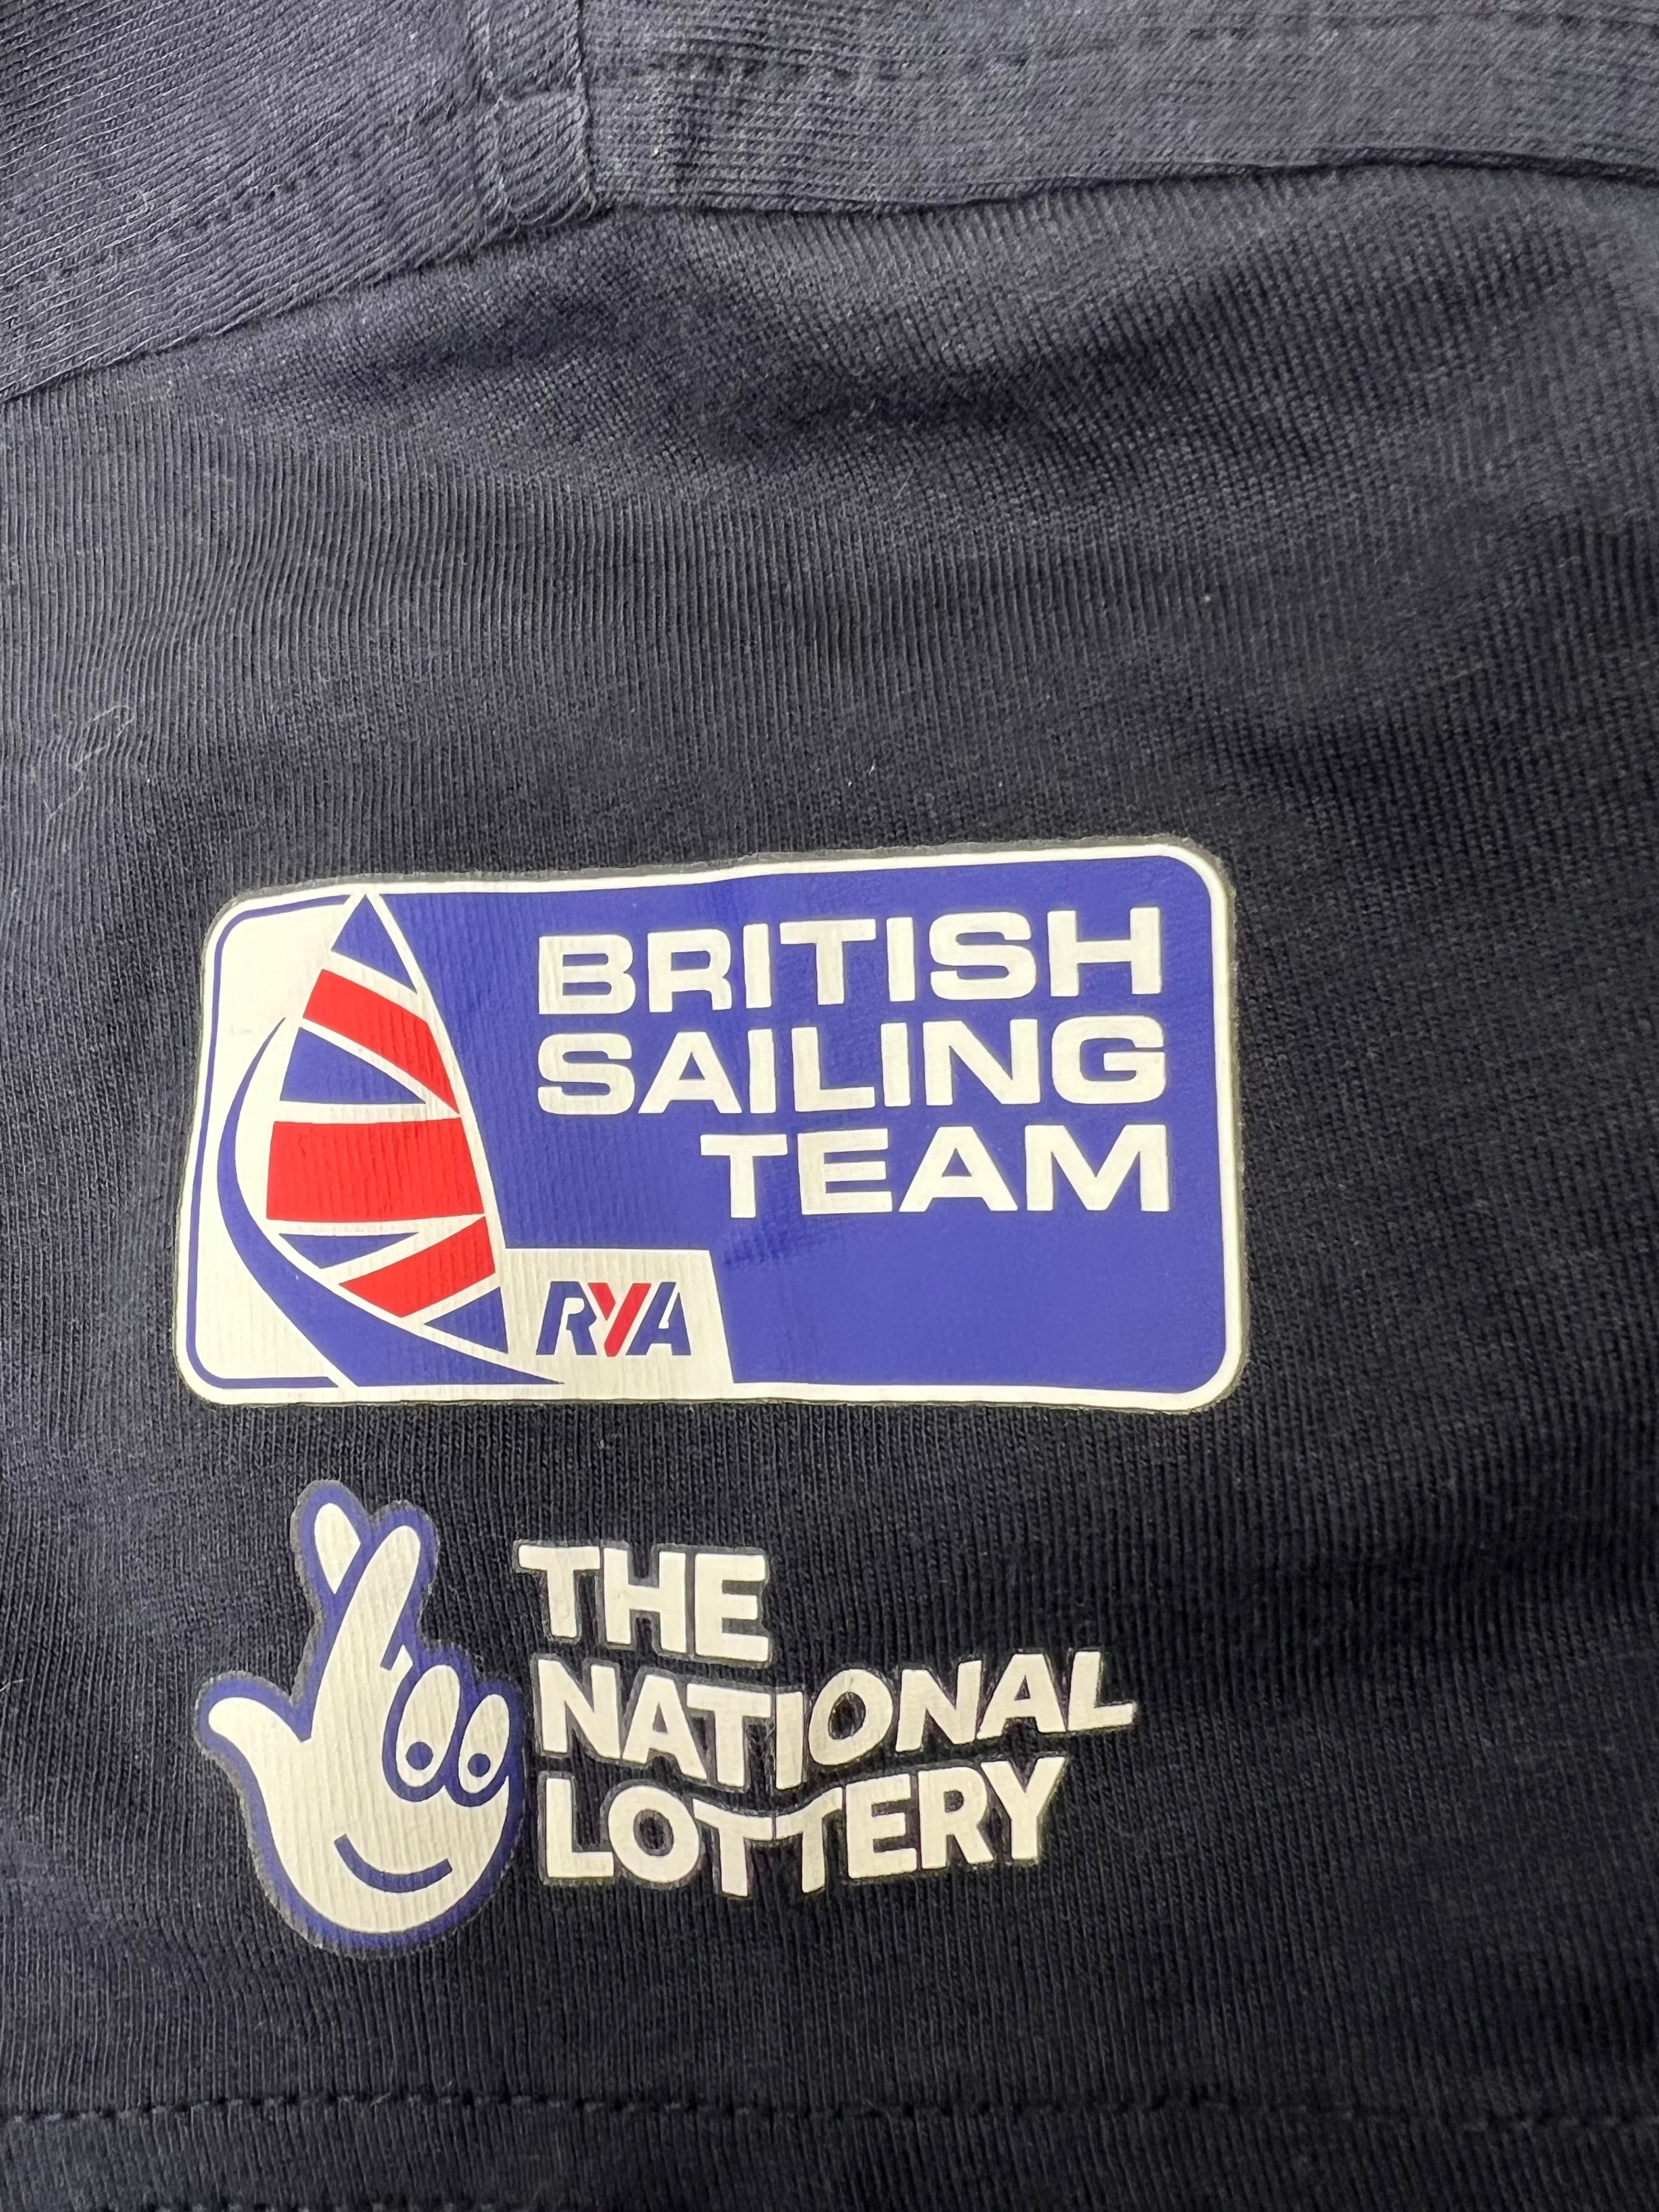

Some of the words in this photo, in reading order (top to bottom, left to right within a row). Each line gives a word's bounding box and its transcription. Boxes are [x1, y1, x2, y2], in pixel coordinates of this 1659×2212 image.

[539, 907, 1162, 1014] BRITISH
[538, 1015, 1166, 1115] SAILING
[700, 1124, 1170, 1218] TEAM
[537, 1281, 691, 1357] RYA
[519, 1545, 769, 1661] THE
[538, 1652, 1136, 1789] NATIONAL
[546, 1757, 1065, 1896] LOTTERY
